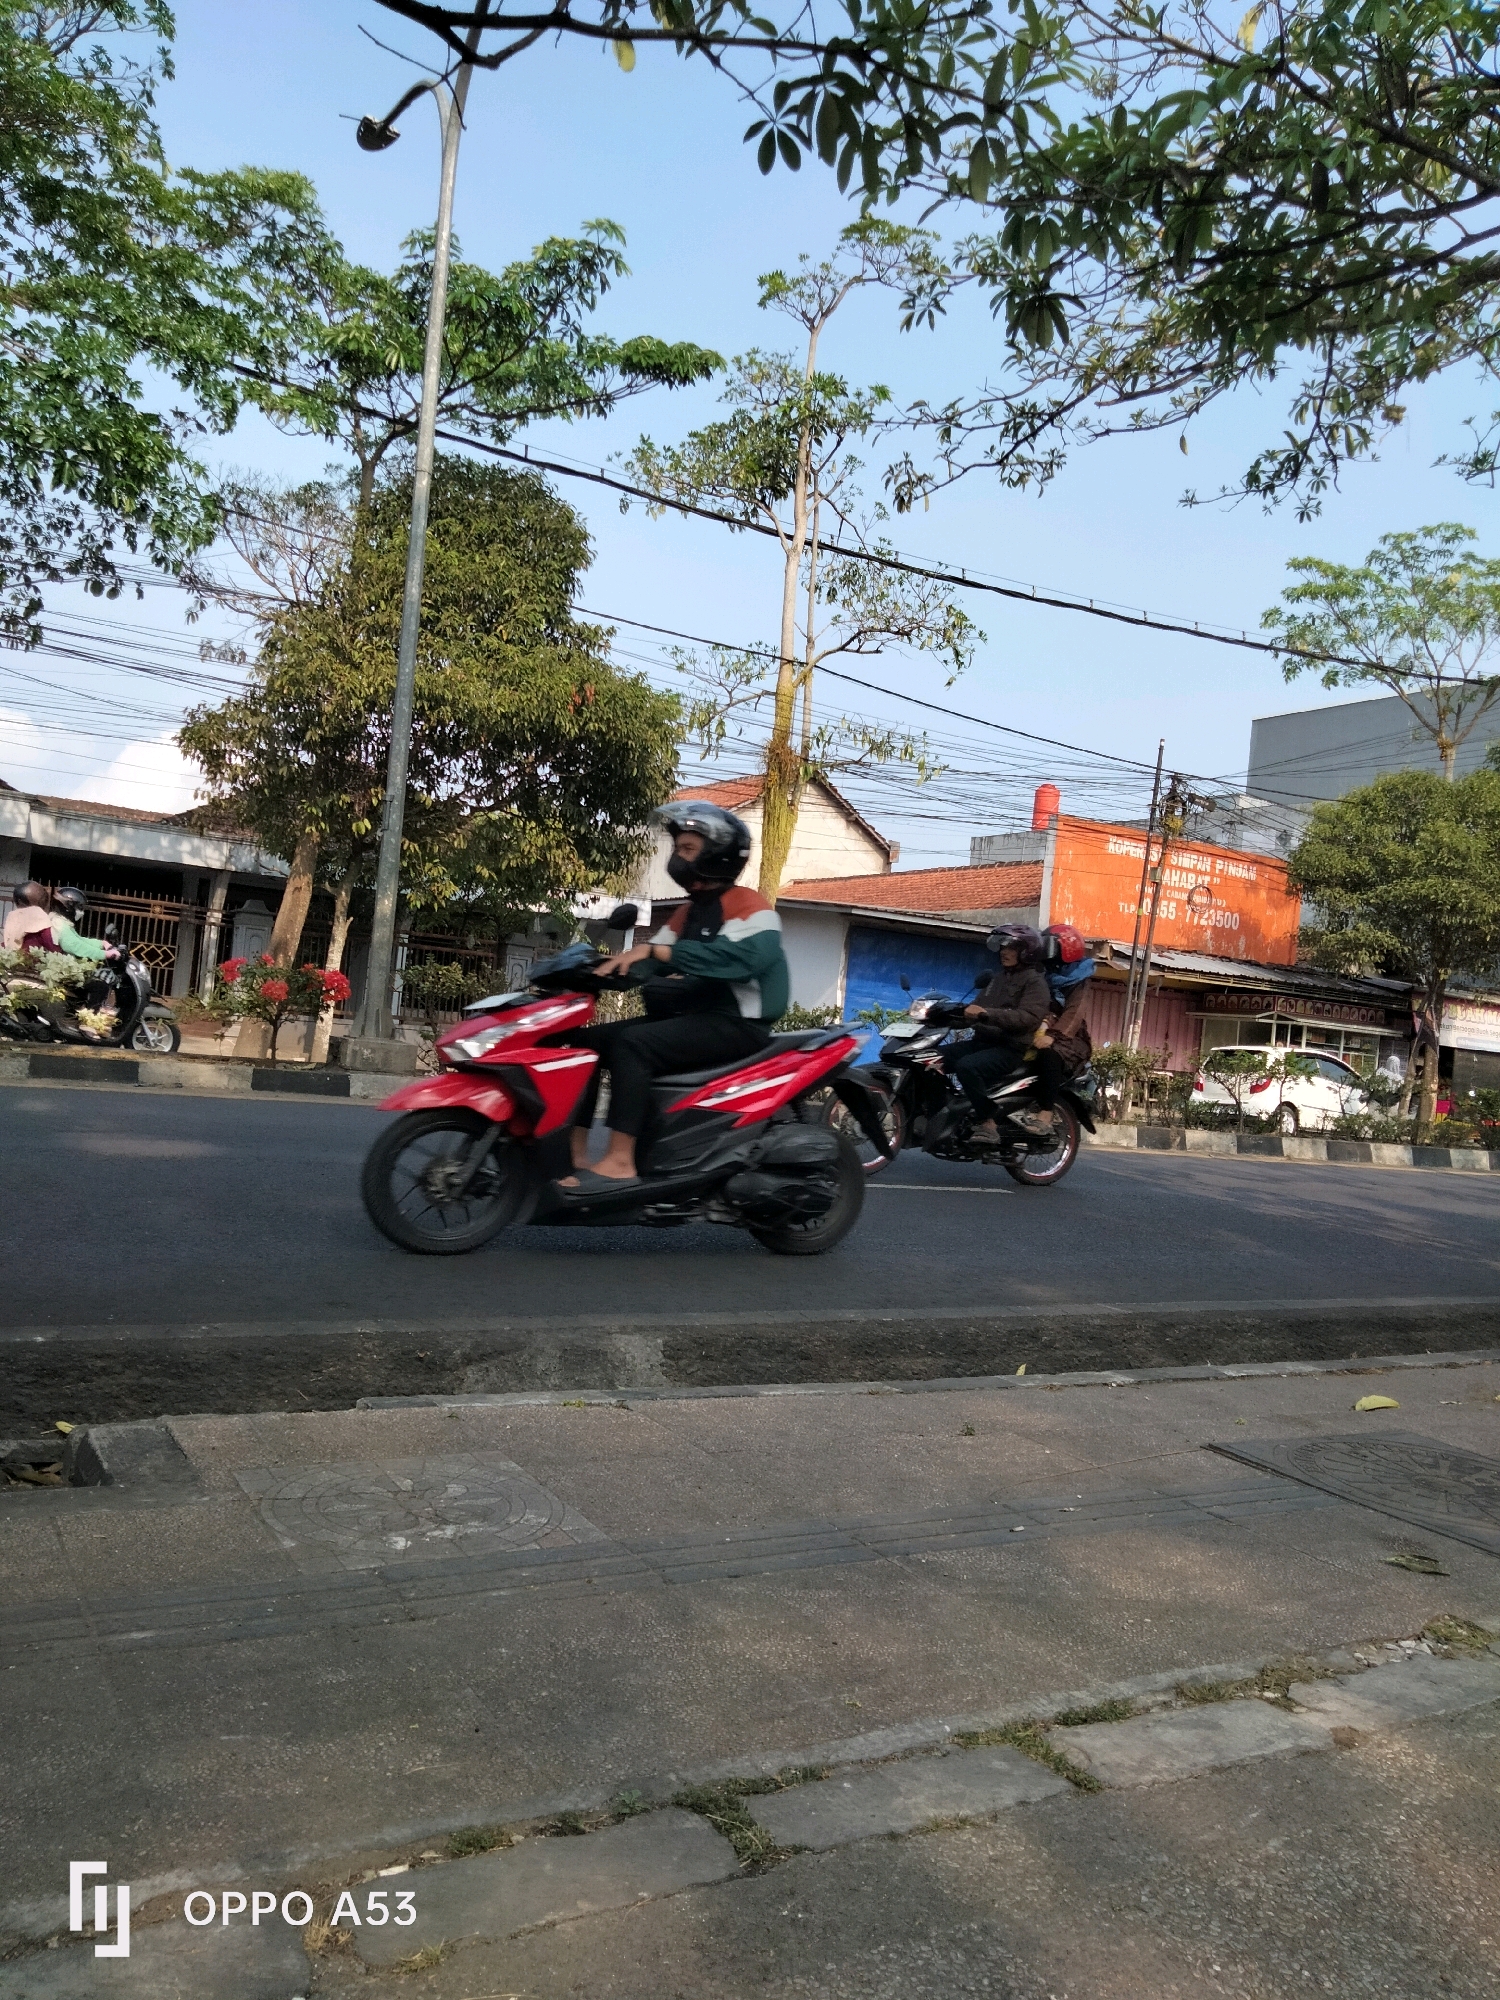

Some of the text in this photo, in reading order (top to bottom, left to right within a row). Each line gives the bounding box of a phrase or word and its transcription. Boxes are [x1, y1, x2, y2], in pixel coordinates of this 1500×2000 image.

[1170, 851, 1211, 872] SIMPAN
[1215, 859, 1257, 880] PINJAM
[1143, 898, 1176, 920] 055
[1448, 1004, 1485, 1024] BUAH
